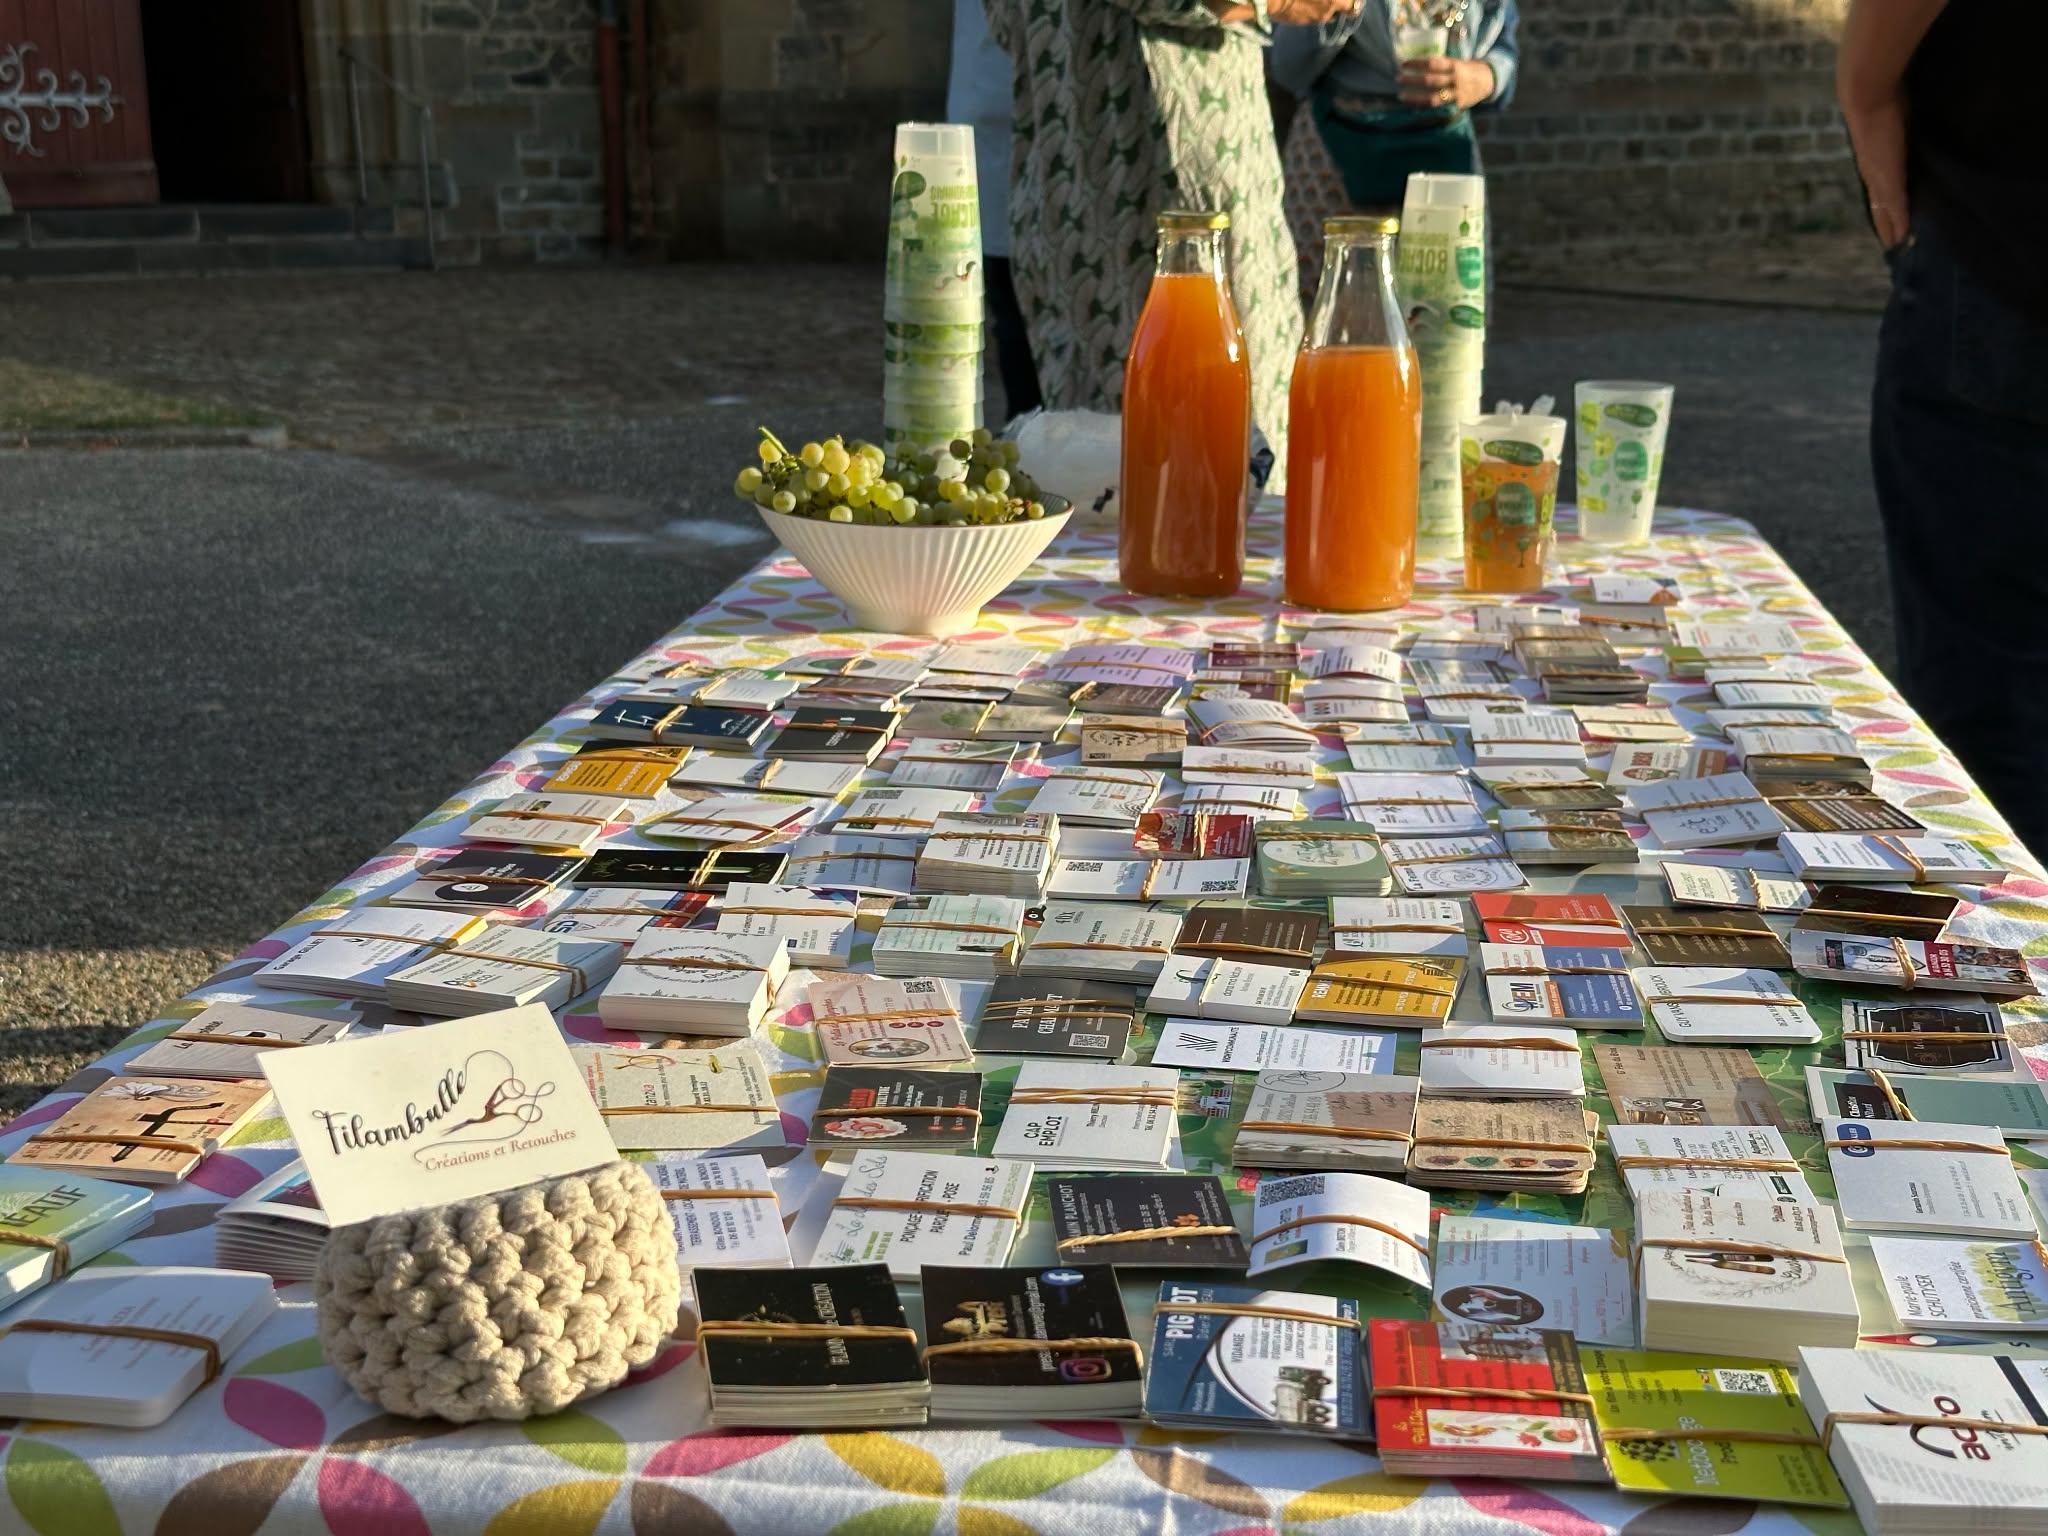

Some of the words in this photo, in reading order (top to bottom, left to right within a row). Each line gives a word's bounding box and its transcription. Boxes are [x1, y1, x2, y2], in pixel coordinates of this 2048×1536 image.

[1011, 997, 1037, 1029] PATRIK
[312, 1067, 467, 1155] Filambulle
[1023, 1122, 1042, 1139] CAP
[1038, 1115, 1062, 1147] EMPLOI
[425, 1148, 491, 1172] Créations
[494, 1145, 506, 1157] et
[510, 1128, 577, 1152] Retouches
[929, 1209, 951, 1234] PARQUE
[941, 1182, 961, 1200] POSE
[1059, 1183, 1080, 1220] PLANCHOT
[899, 1214, 923, 1243] PONÇAGE
[957, 1241, 975, 1256] Paul
[1064, 1221, 1087, 1254] BEAMIN
[1164, 1286, 1199, 1340] PIGOT
[1914, 1274, 1948, 1319] SCHUTYSER
[1933, 1394, 1991, 1461] aco
[1679, 1416, 1721, 1486] Netbocge
